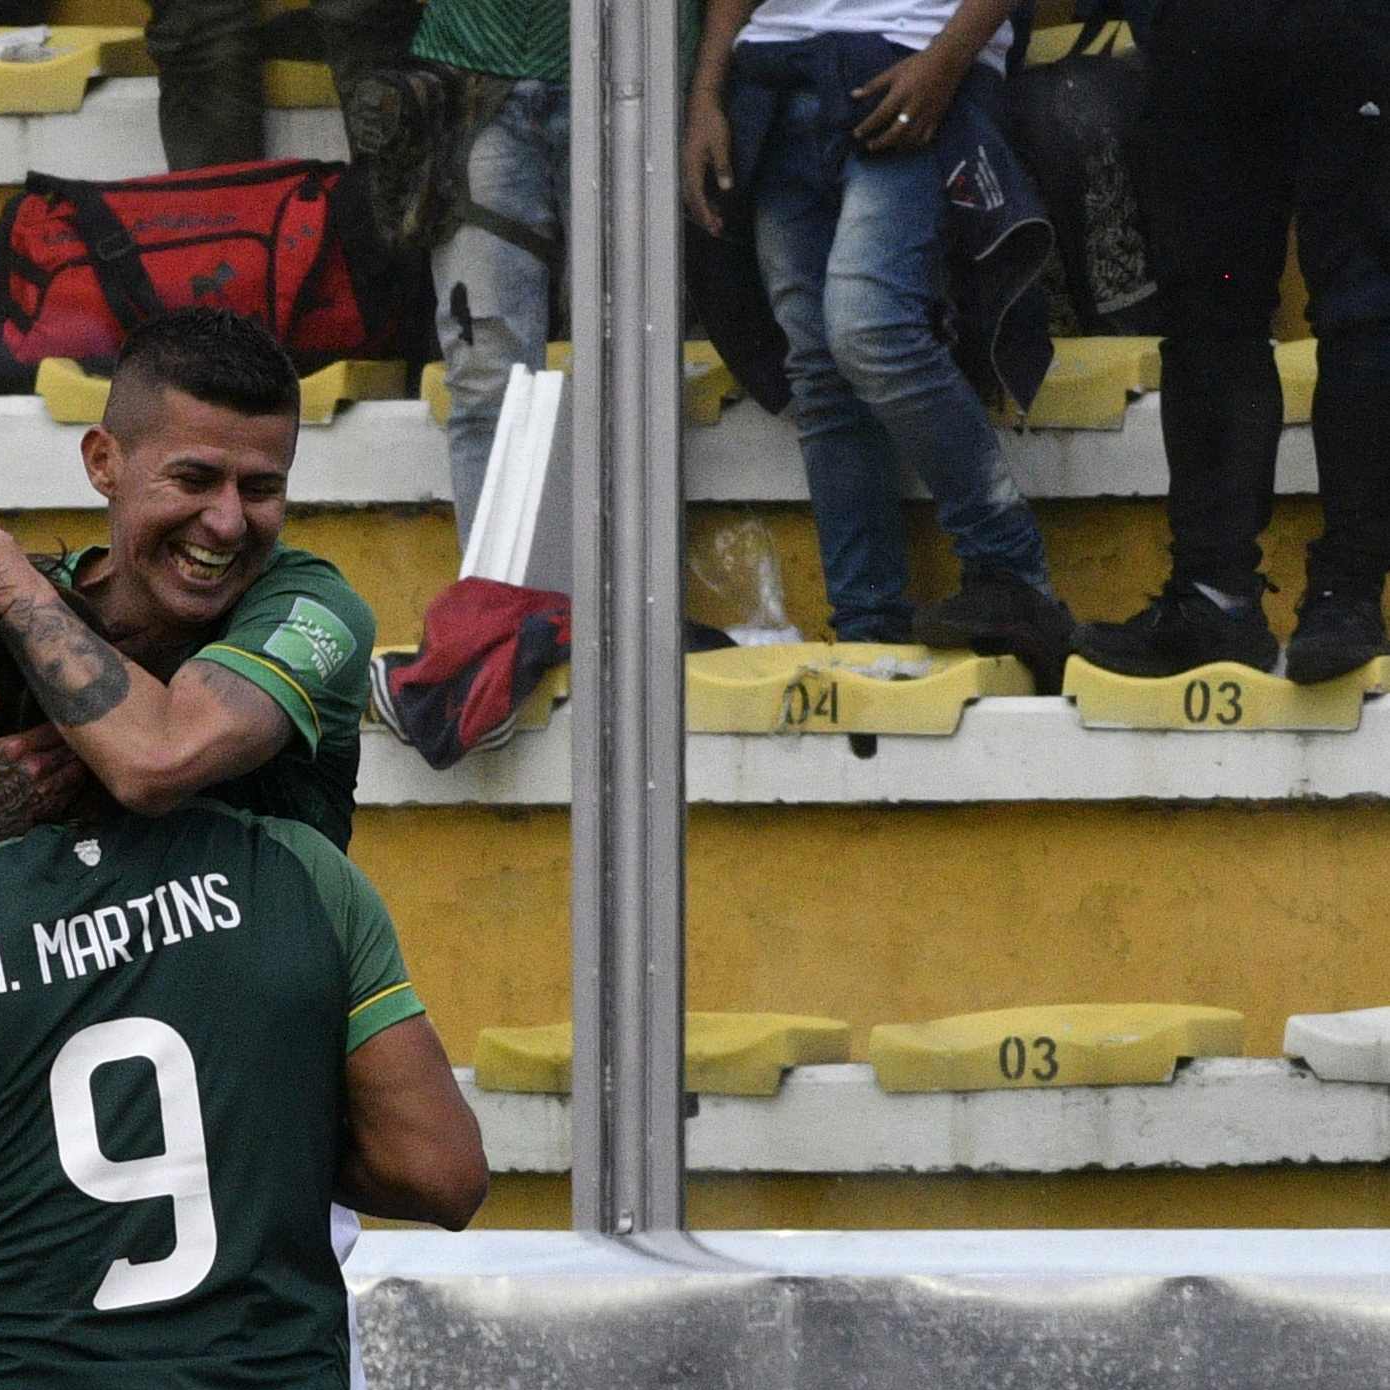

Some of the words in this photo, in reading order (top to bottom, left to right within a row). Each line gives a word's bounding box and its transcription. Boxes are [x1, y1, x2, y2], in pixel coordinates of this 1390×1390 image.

[786, 680, 840, 726] 04
[1184, 680, 1244, 725] 03
[32, 872, 241, 985] MARTINS
[998, 1036, 1060, 1082] 03
[49, 1016, 218, 1312] 9
